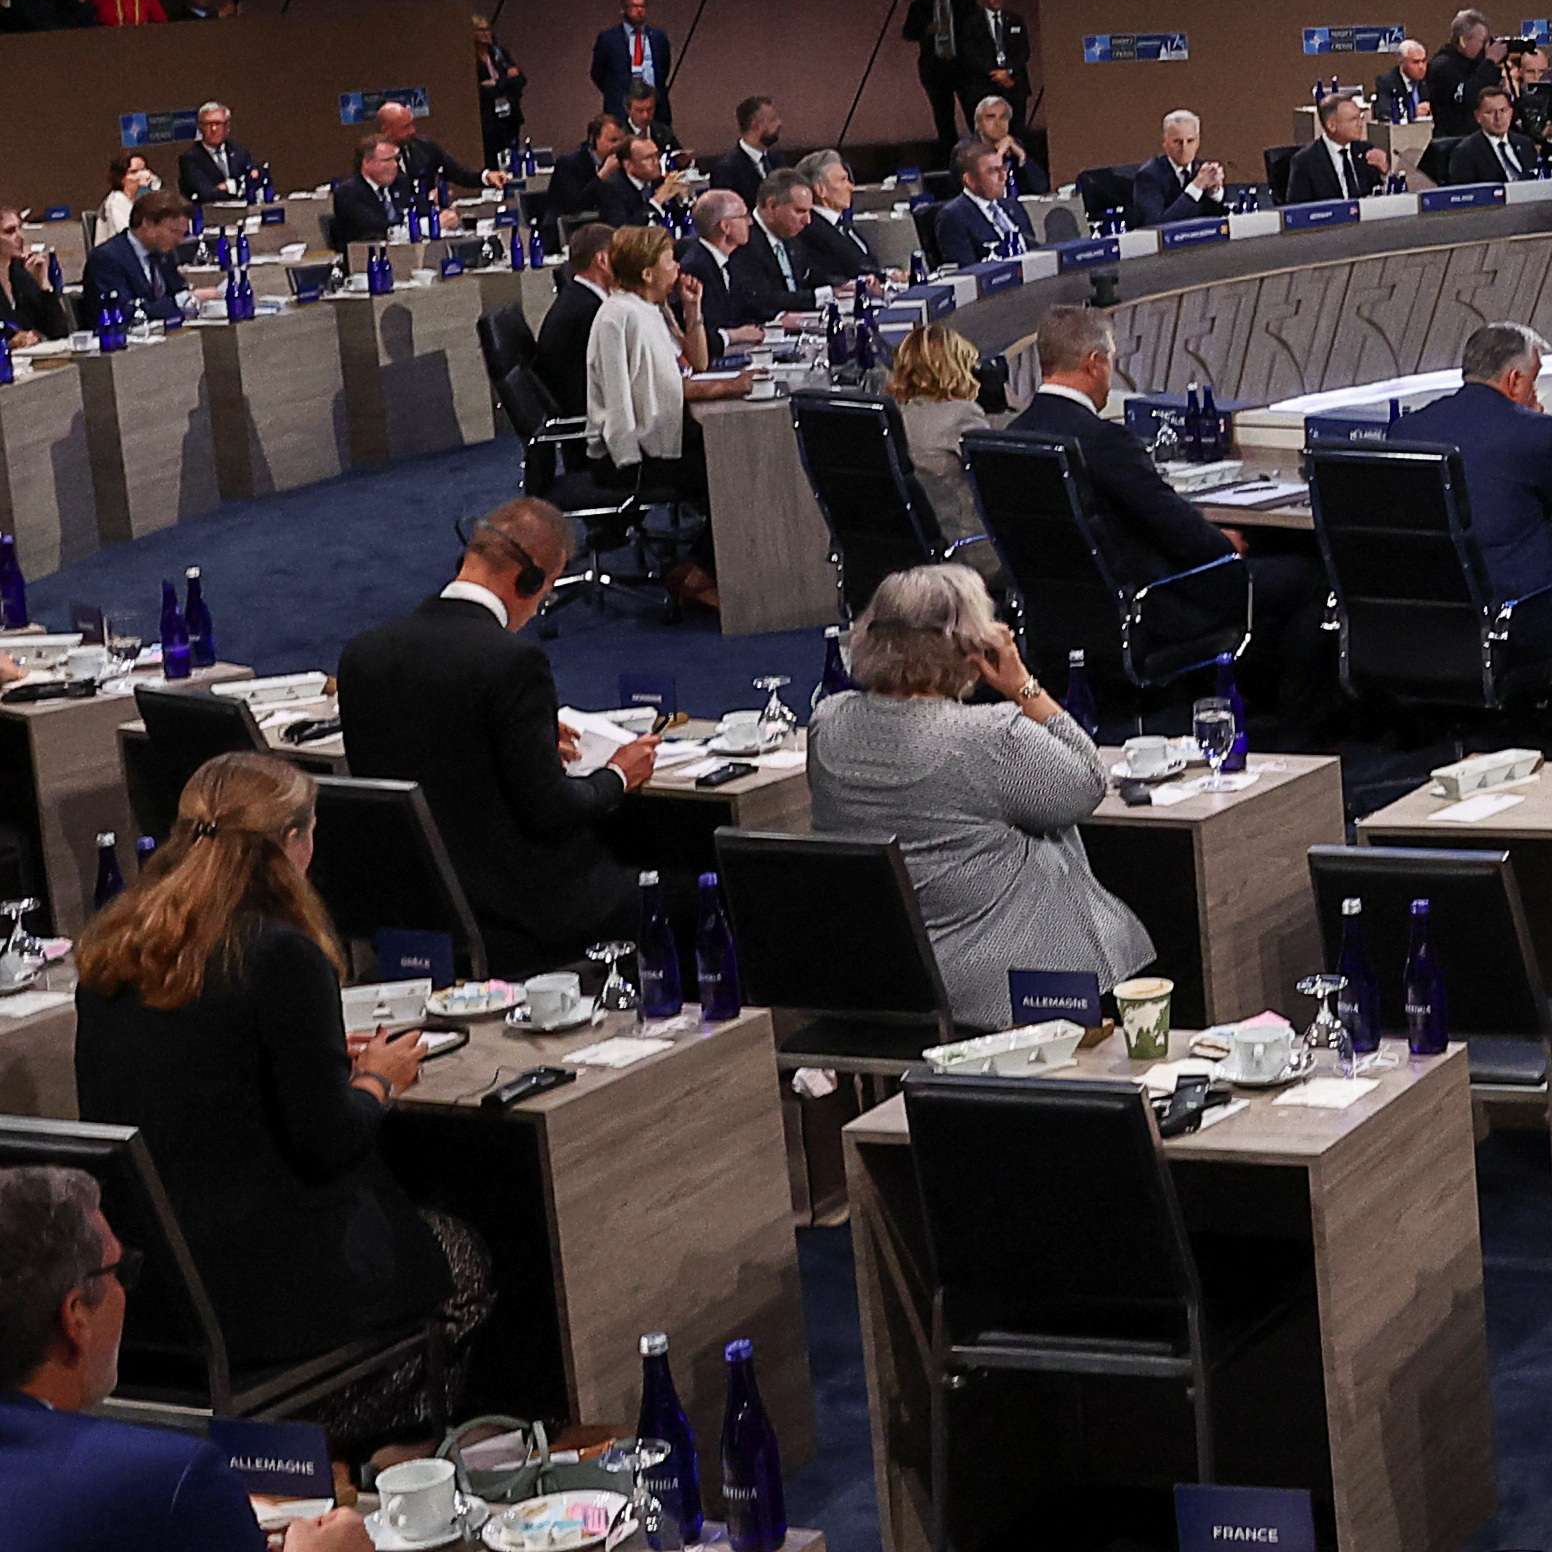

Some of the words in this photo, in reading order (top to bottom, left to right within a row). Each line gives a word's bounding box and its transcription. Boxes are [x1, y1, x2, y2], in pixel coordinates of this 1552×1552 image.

[1022, 995, 1088, 1010] ALLEMAGNE
[230, 1455, 315, 1476] ALLEMAGNE
[1213, 1525, 1280, 1544] FRANCE
